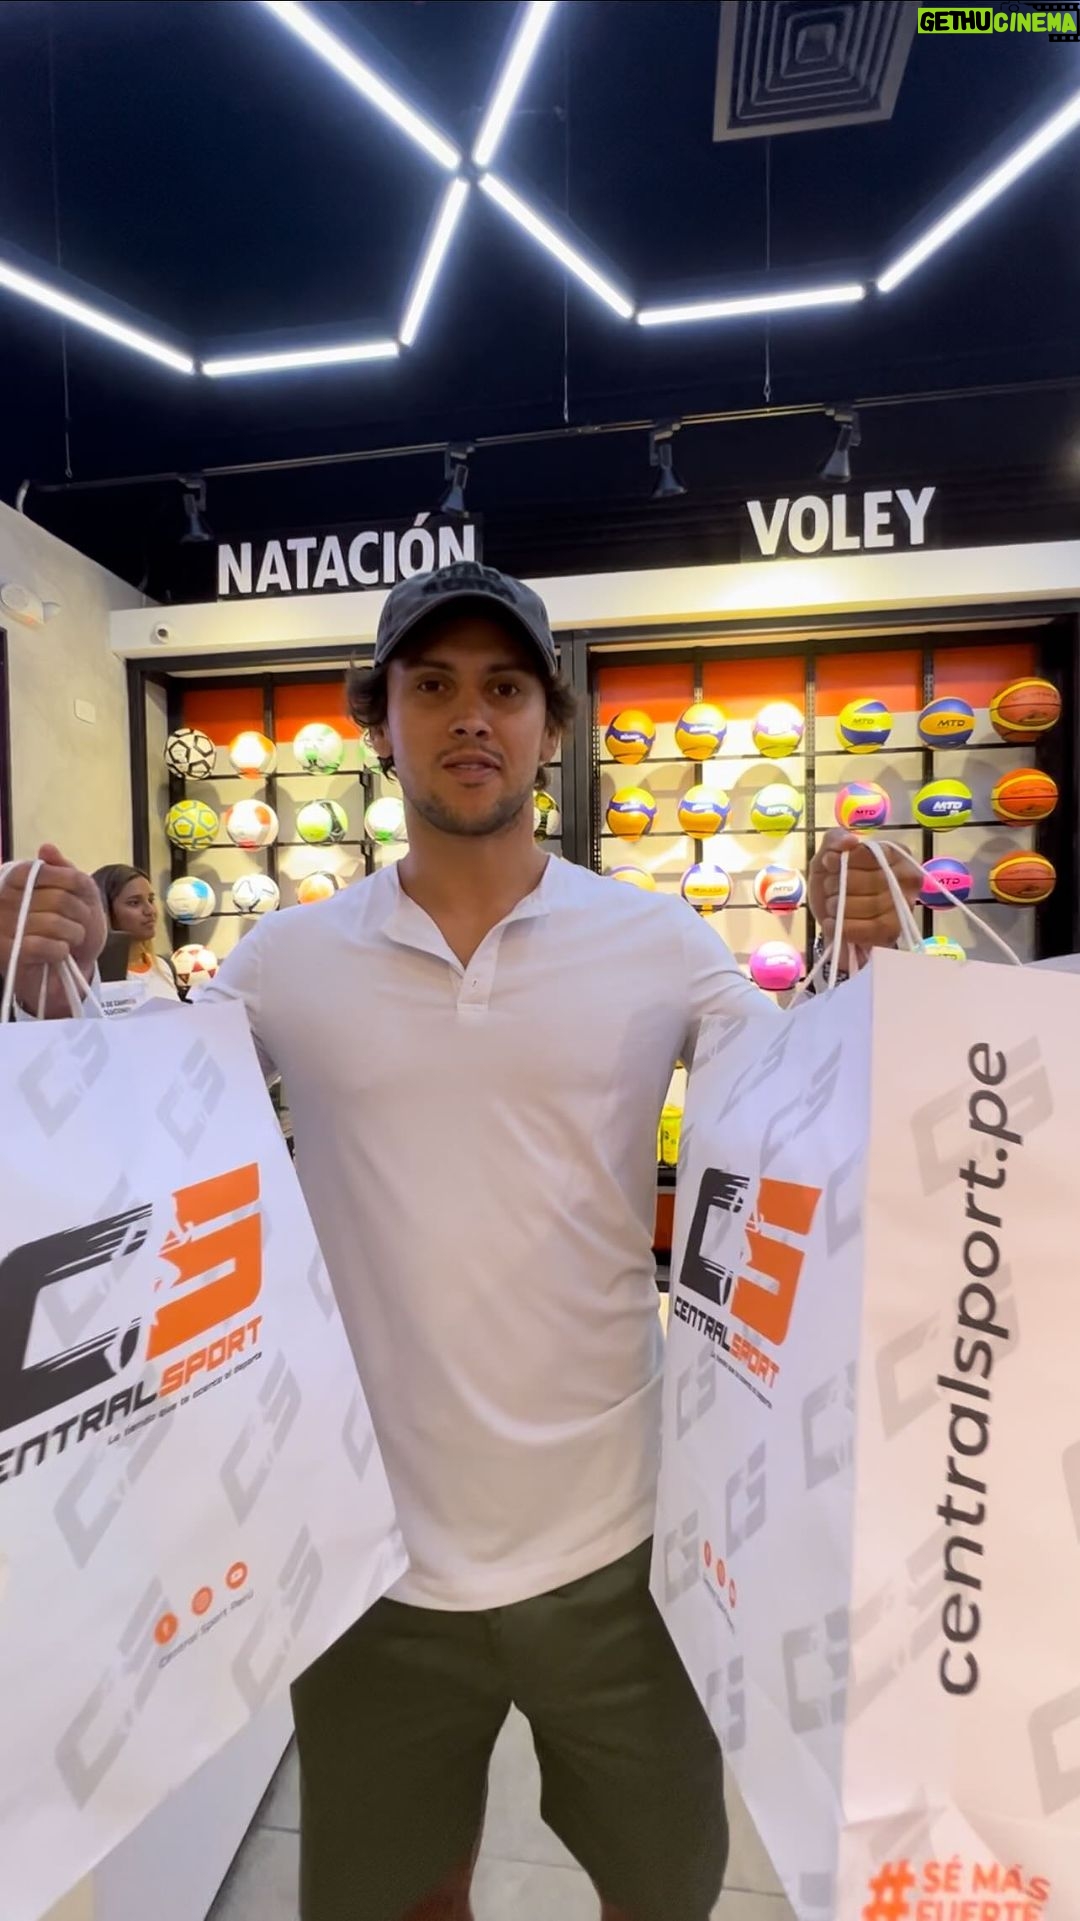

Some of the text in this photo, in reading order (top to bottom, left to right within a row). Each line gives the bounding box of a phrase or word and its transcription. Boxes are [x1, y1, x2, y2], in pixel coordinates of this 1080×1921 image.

[746, 486, 937, 556] VOLEY
[216, 511, 476, 596] NATACIÓN
[852, 717, 875, 726] MTD
[937, 719, 966, 727] MTD
[855, 808, 876, 816] MTD
[933, 800, 963, 811] MTD
[936, 1041, 1023, 1697] centralsport.pe
[971, 1862, 1051, 1903] MÁS
